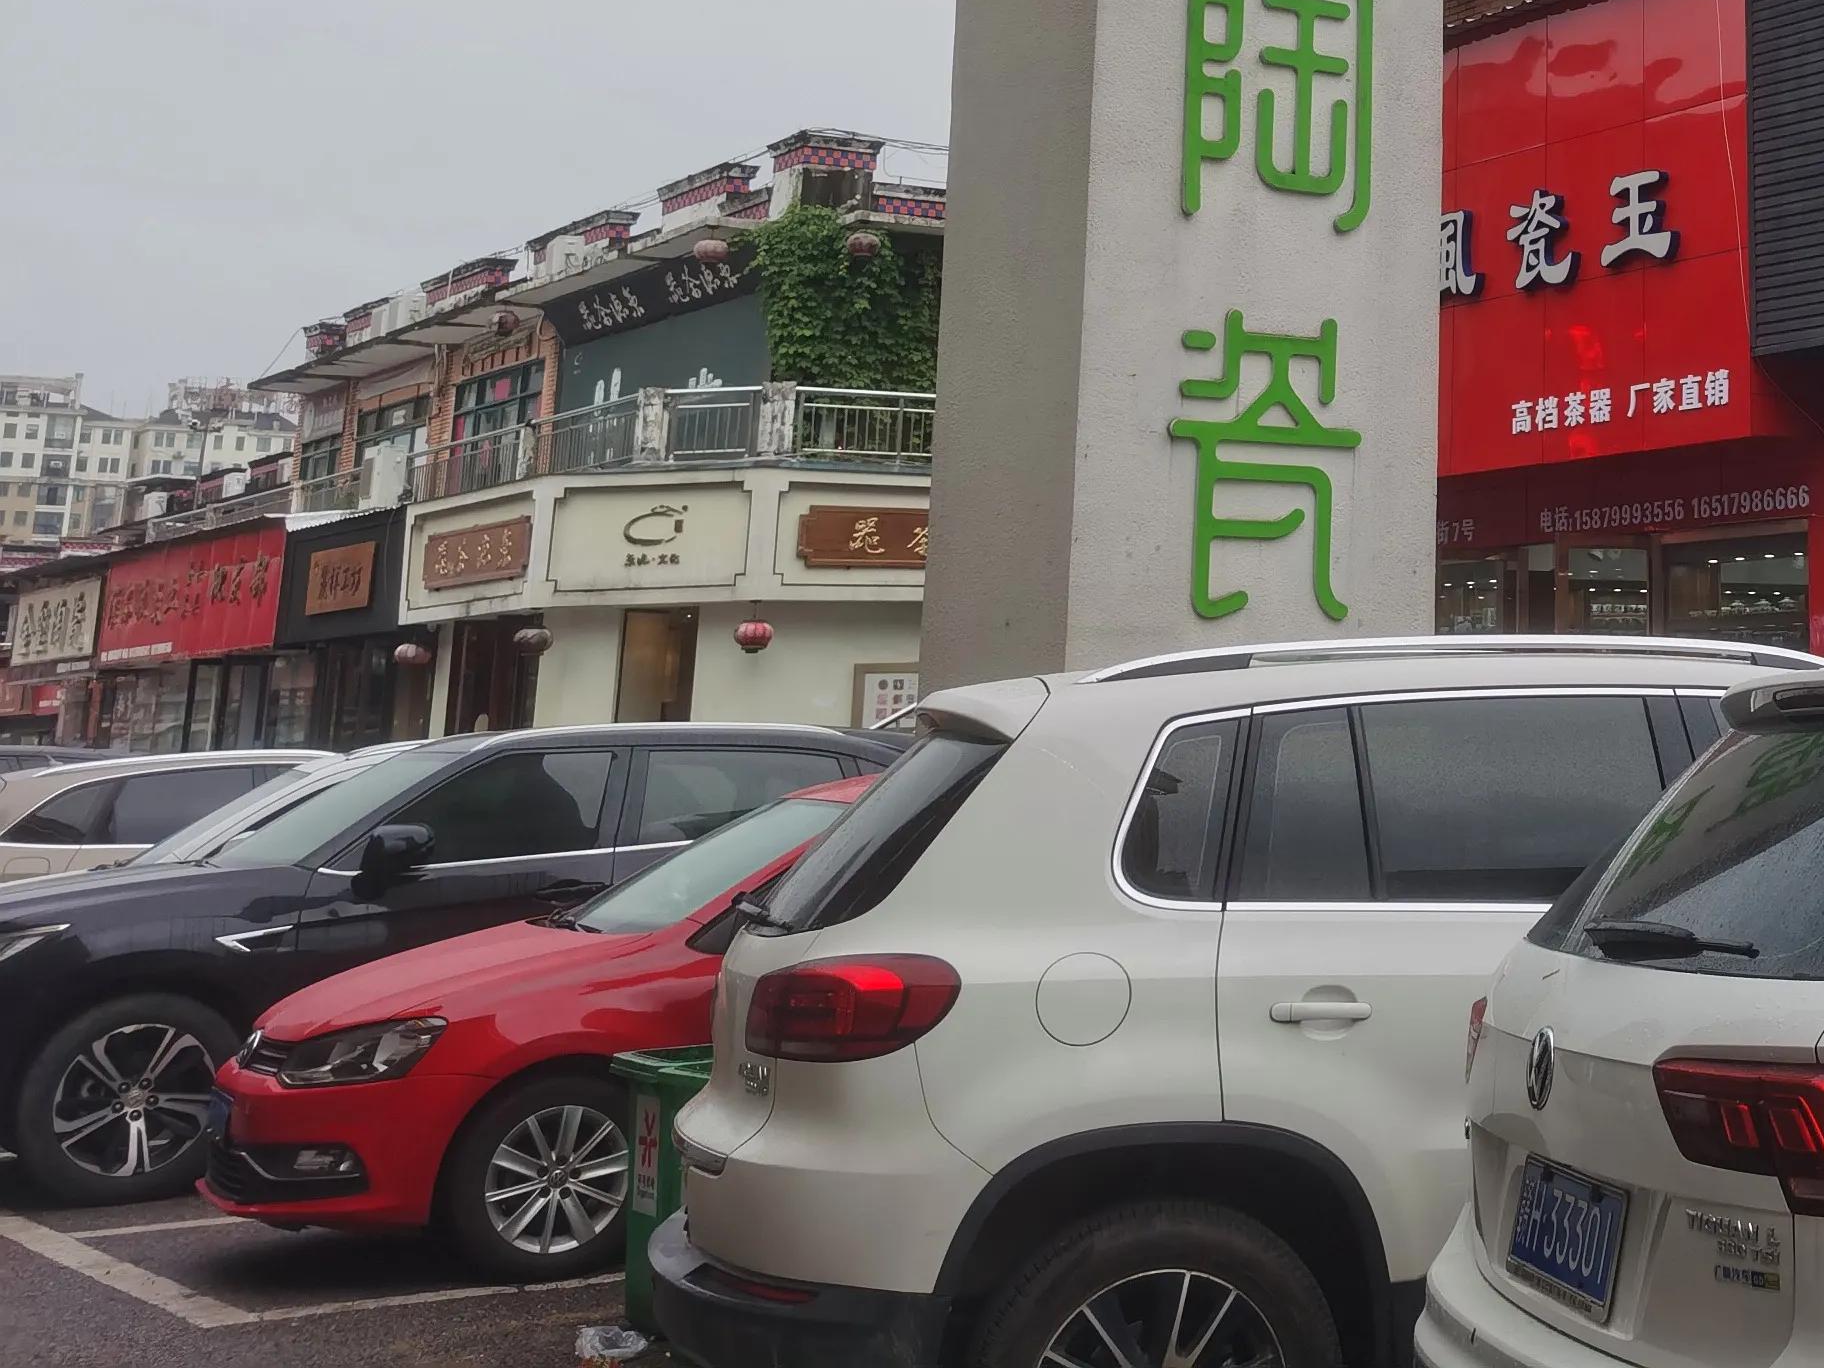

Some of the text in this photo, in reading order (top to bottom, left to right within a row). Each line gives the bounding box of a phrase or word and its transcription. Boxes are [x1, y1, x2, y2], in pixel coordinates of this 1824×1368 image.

[1511, 368, 1731, 435] 高档茶器 厂家直销
